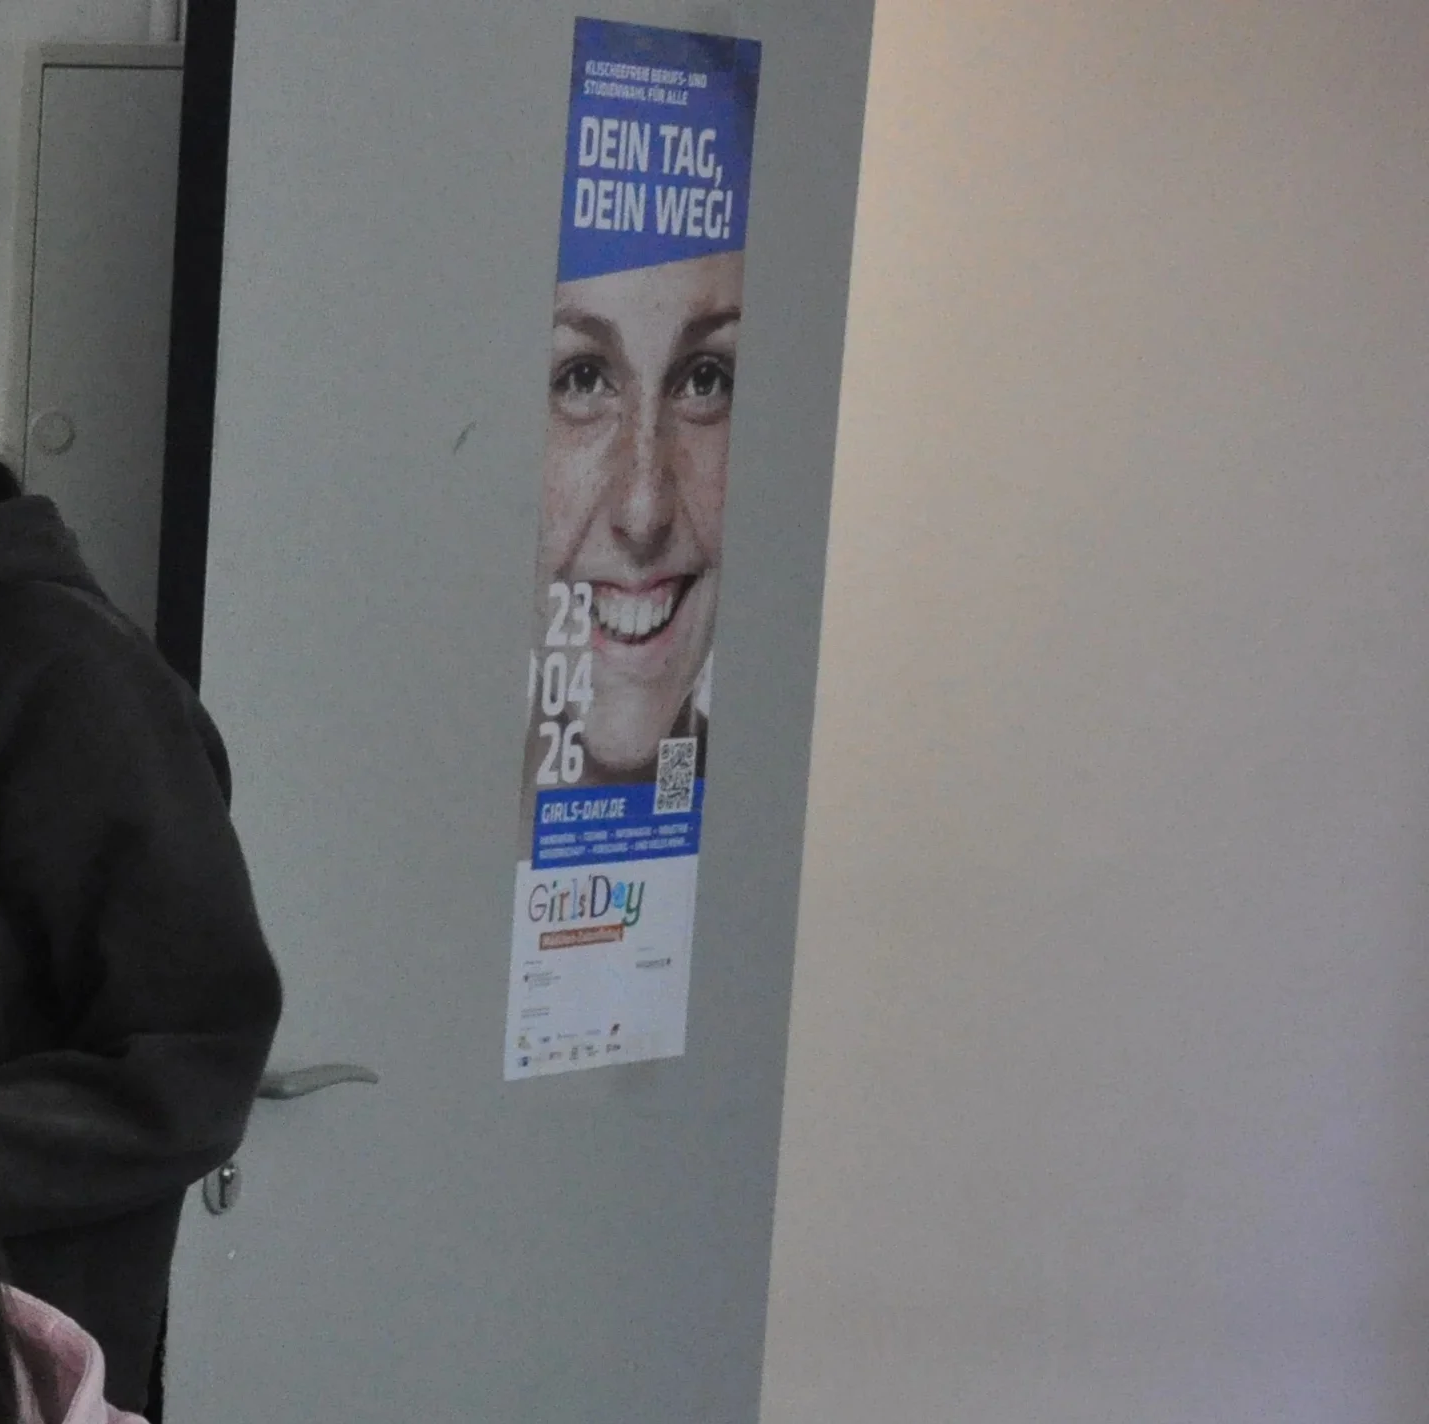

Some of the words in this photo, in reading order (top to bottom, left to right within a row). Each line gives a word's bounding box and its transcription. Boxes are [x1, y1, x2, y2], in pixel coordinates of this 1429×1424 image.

[666, 89, 689, 106] ALLE
[578, 116, 651, 172] DEIN
[659, 125, 723, 186] TAG,
[574, 178, 647, 232] DEIN
[655, 184, 733, 240] WEG!
[545, 581, 593, 647] 23
[536, 719, 586, 785] 26
[541, 797, 627, 824] GIRLS-DAY.DE
